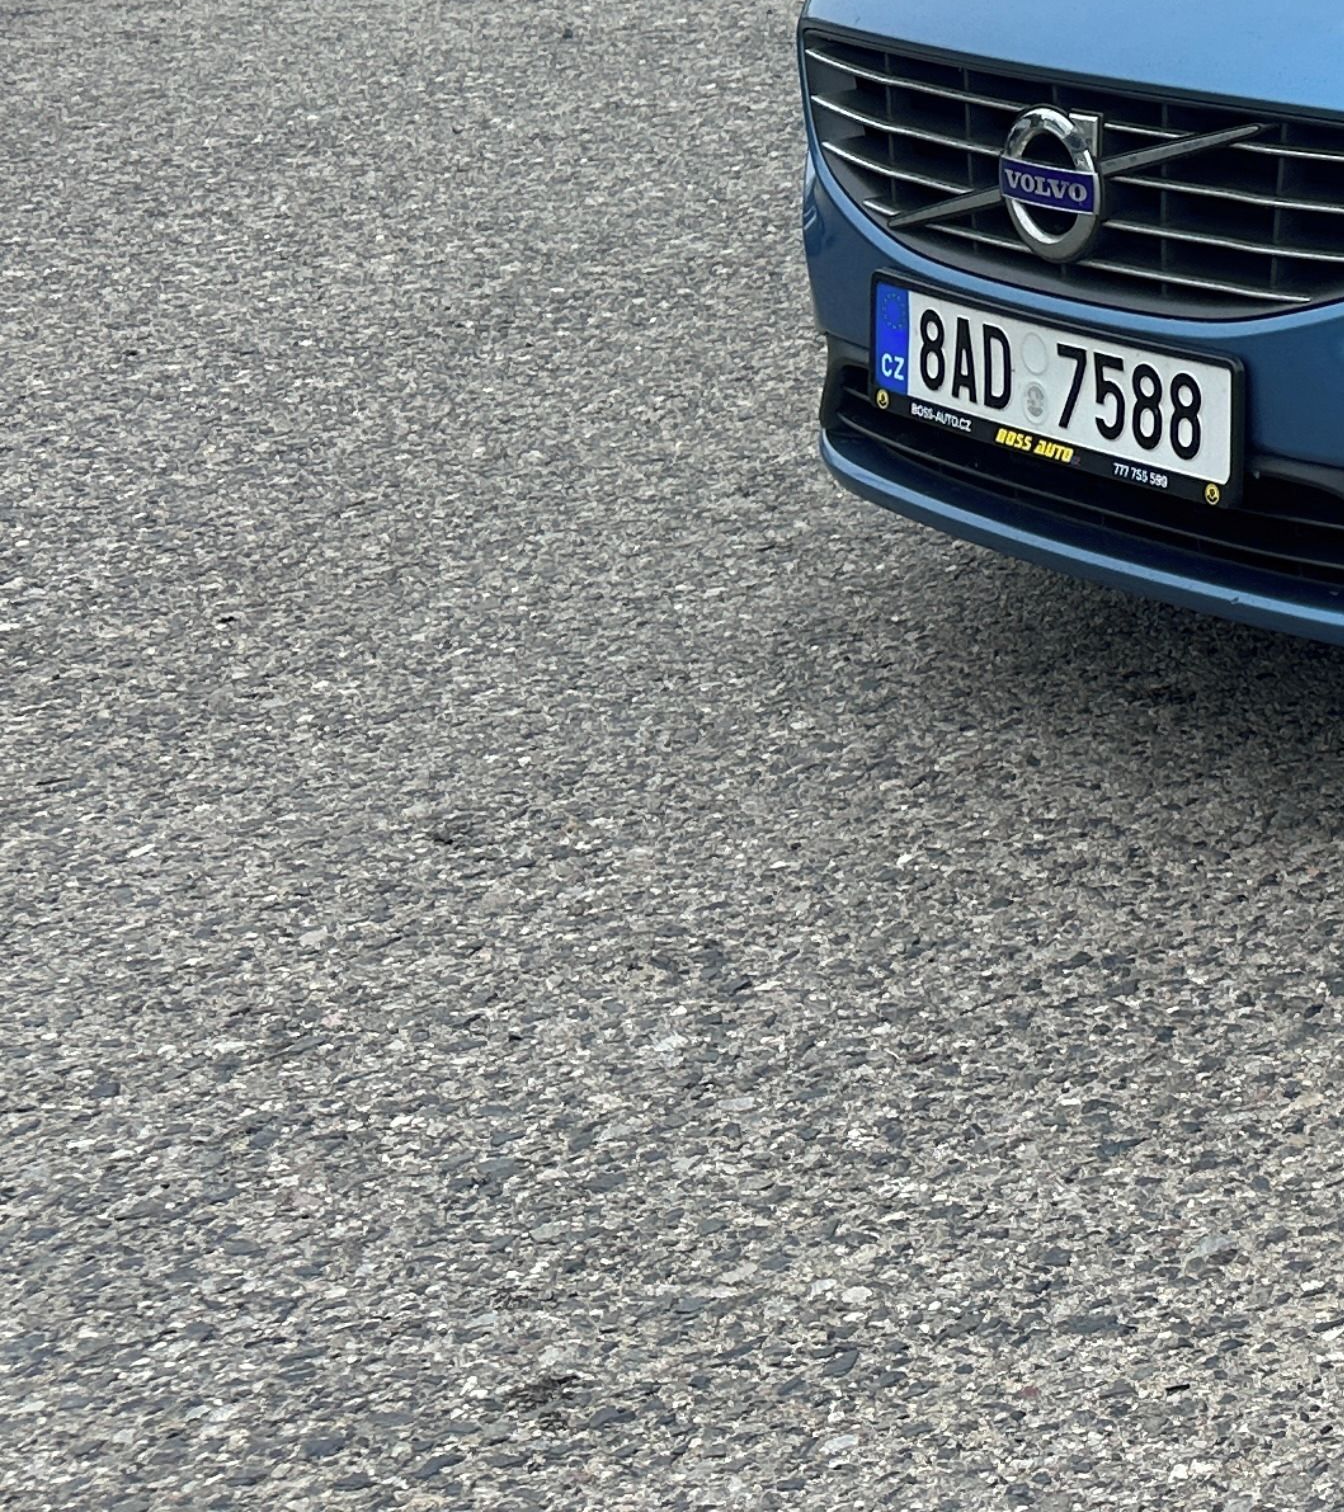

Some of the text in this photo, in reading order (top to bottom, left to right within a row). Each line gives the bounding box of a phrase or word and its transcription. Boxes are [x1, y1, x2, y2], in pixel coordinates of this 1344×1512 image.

[1004, 169, 1088, 202] VOLVO
[881, 353, 905, 381] CZ
[920, 309, 1202, 461] 8AD 7588
[911, 402, 972, 433] BOSS-AUTO.CZ
[995, 428, 1033, 451] BOSS
[1033, 440, 1074, 463] AUTO
